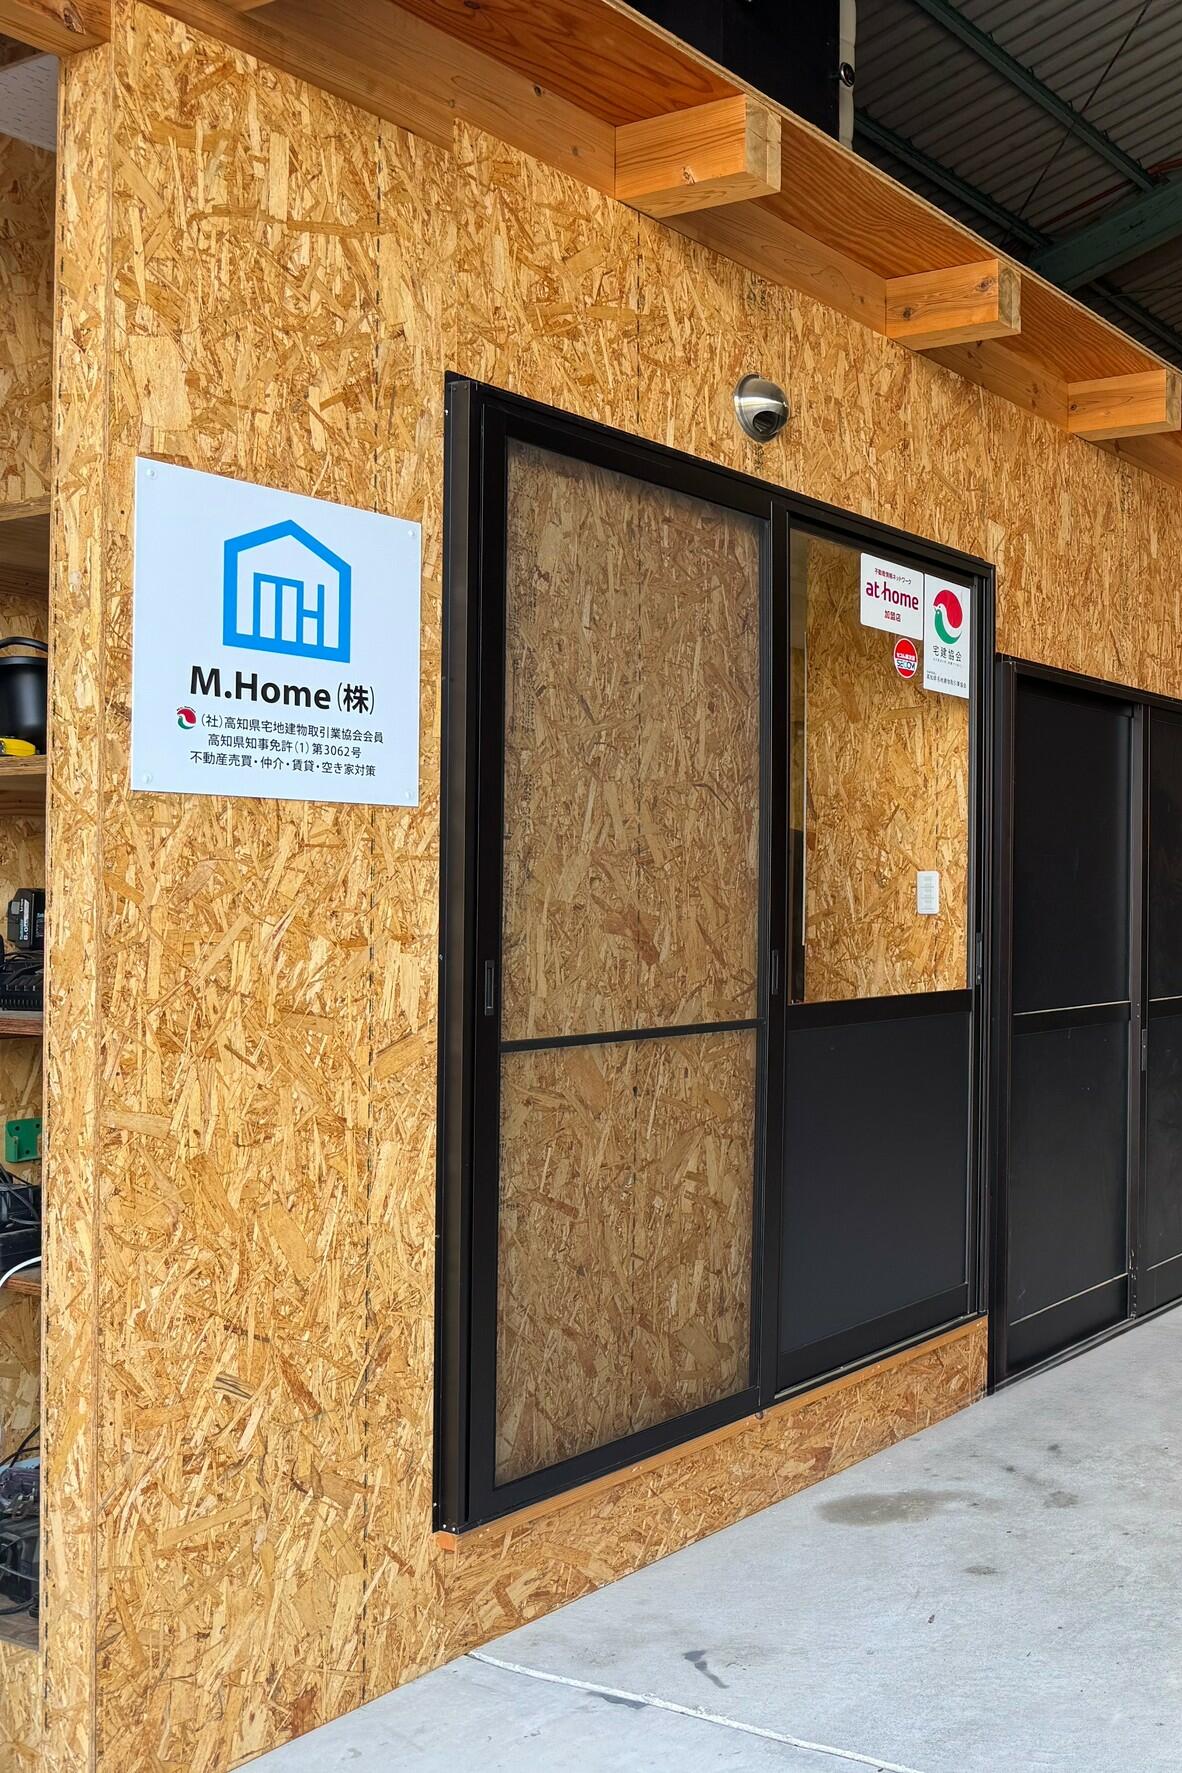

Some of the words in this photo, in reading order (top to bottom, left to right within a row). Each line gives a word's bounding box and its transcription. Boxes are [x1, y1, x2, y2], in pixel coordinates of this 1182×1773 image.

[865, 581, 880, 598] at
[881, 581, 919, 610] home
[190, 665, 332, 710] M.Home
